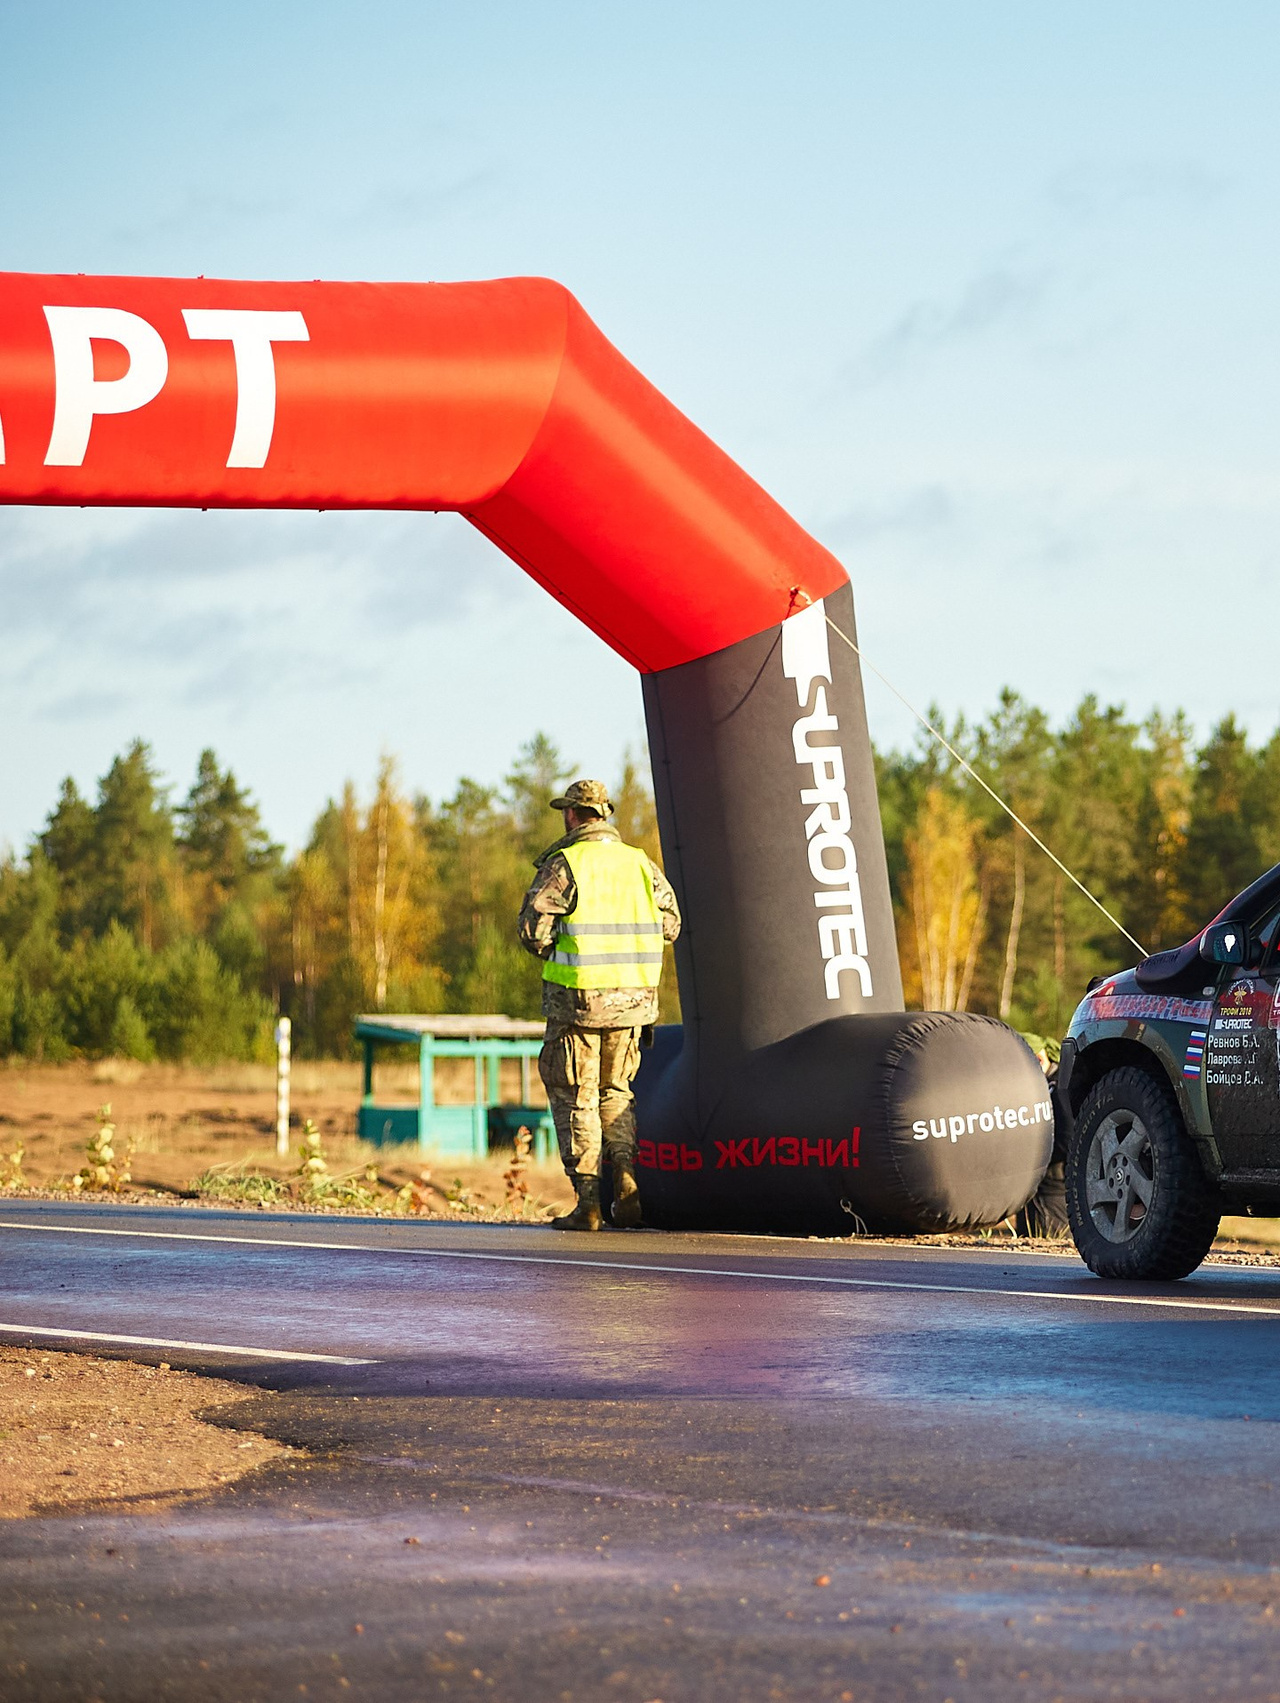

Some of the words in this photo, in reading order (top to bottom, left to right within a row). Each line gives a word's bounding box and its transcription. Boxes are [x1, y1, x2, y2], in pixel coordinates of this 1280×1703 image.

[0, 304, 310, 469] РТ
[782, 598, 873, 1000] SUPROTEC
[1208, 1034, 1241, 1048] Ревнов
[1206, 1070, 1242, 1087] Бойцов
[912, 1100, 1052, 1143] suprotec.ru
[632, 1138, 703, 1171] авь
